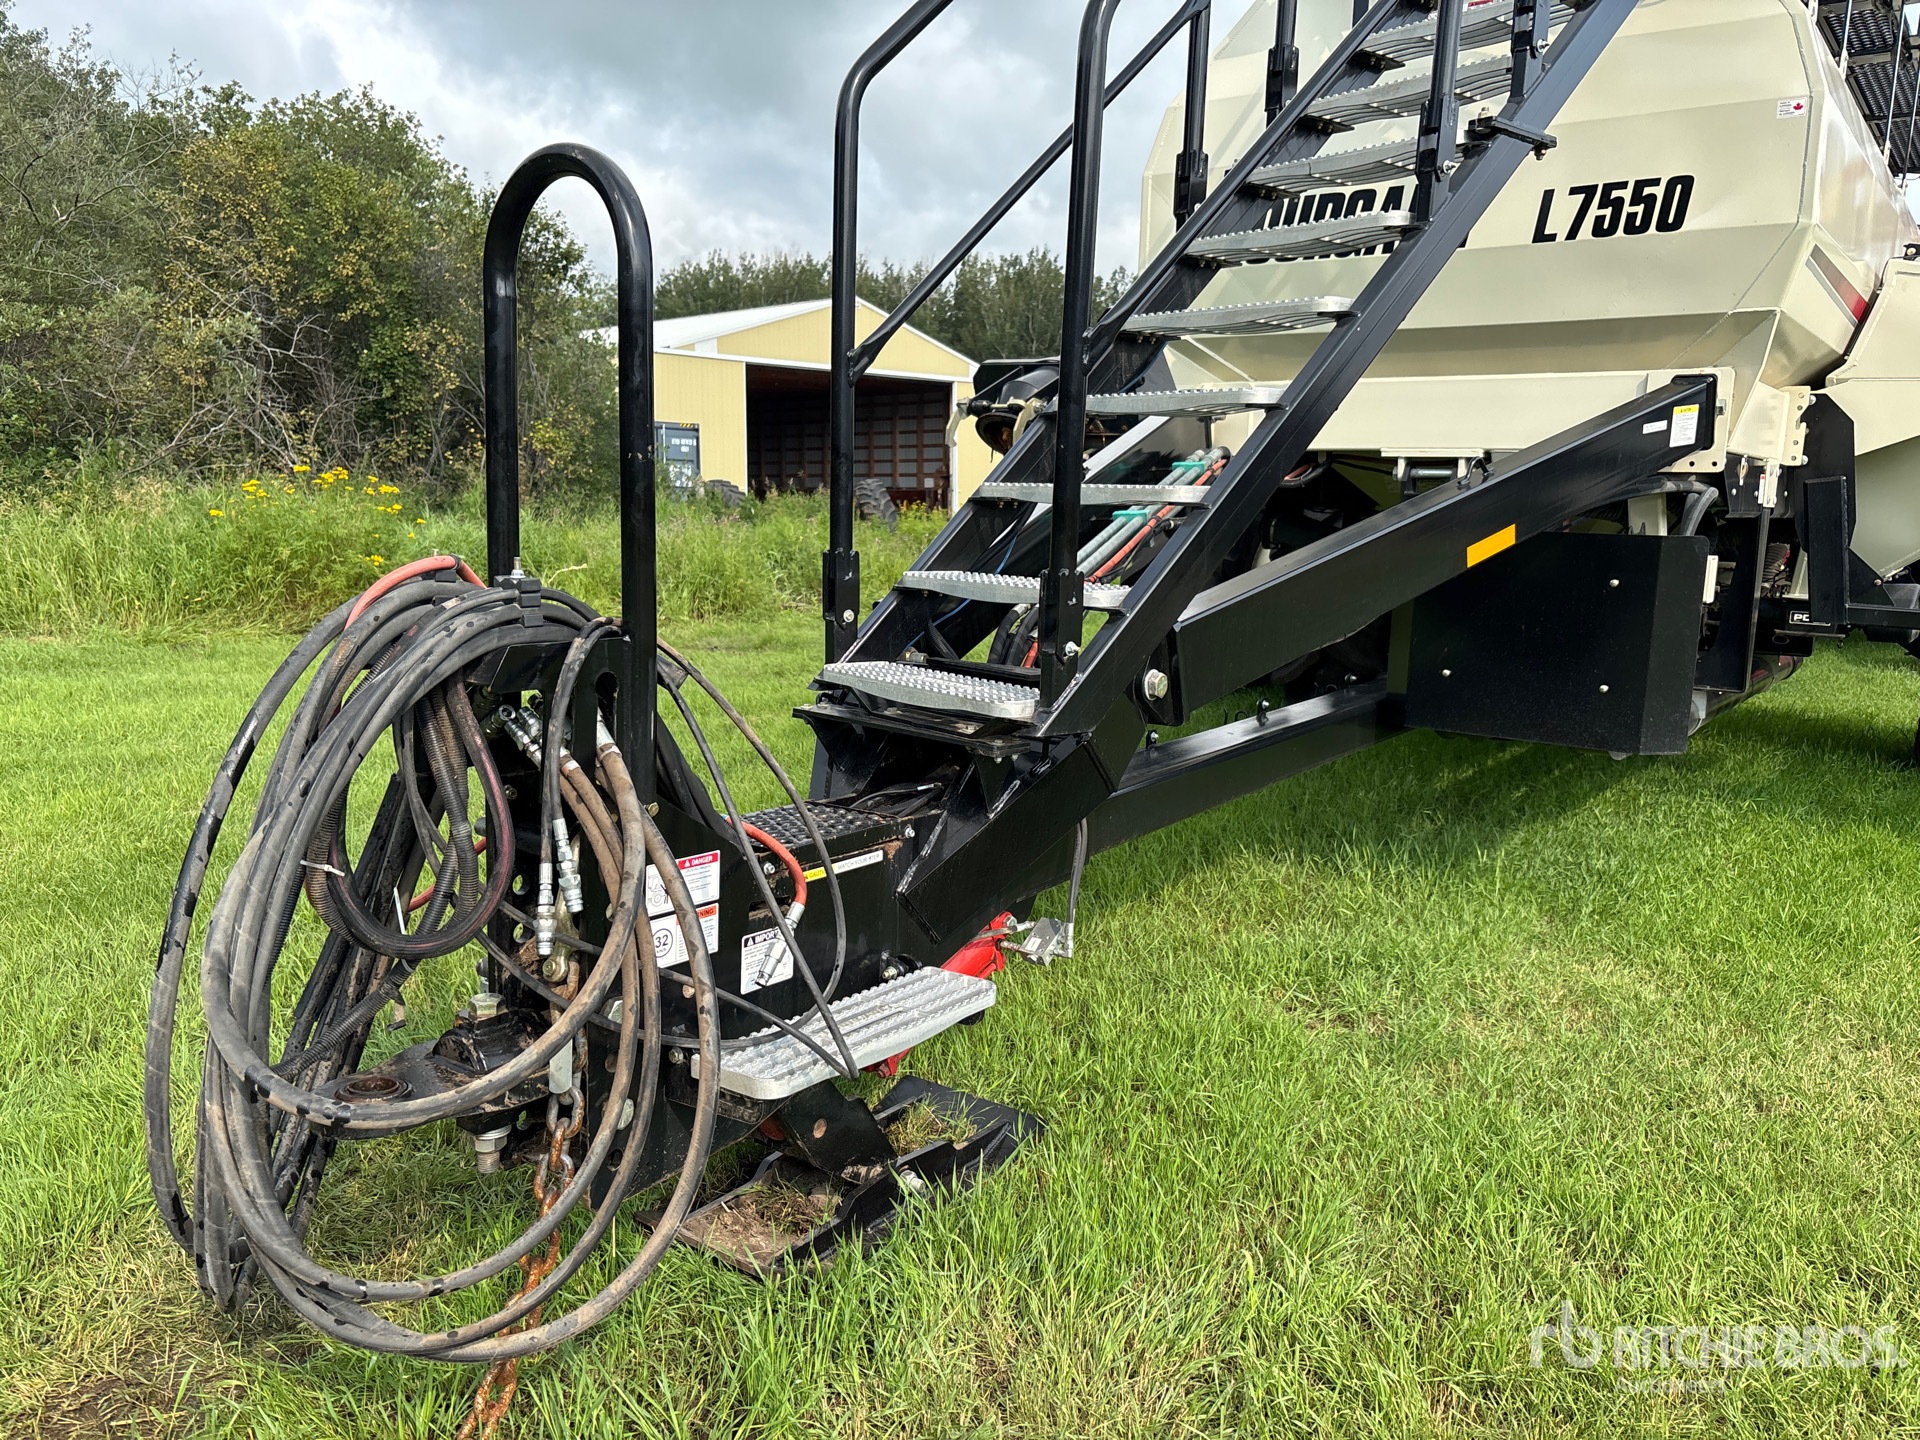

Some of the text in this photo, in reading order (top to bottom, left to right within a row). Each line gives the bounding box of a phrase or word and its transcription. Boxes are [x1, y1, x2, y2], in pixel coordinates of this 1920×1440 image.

[1532, 174, 1696, 245] L7550
[691, 855, 713, 866] DANGER
[837, 860, 854, 870] WATCH
[854, 857, 868, 866] YOUR
[698, 908, 714, 918] NING
[655, 934, 669, 949] 32
[754, 930, 778, 944] IMPOR
